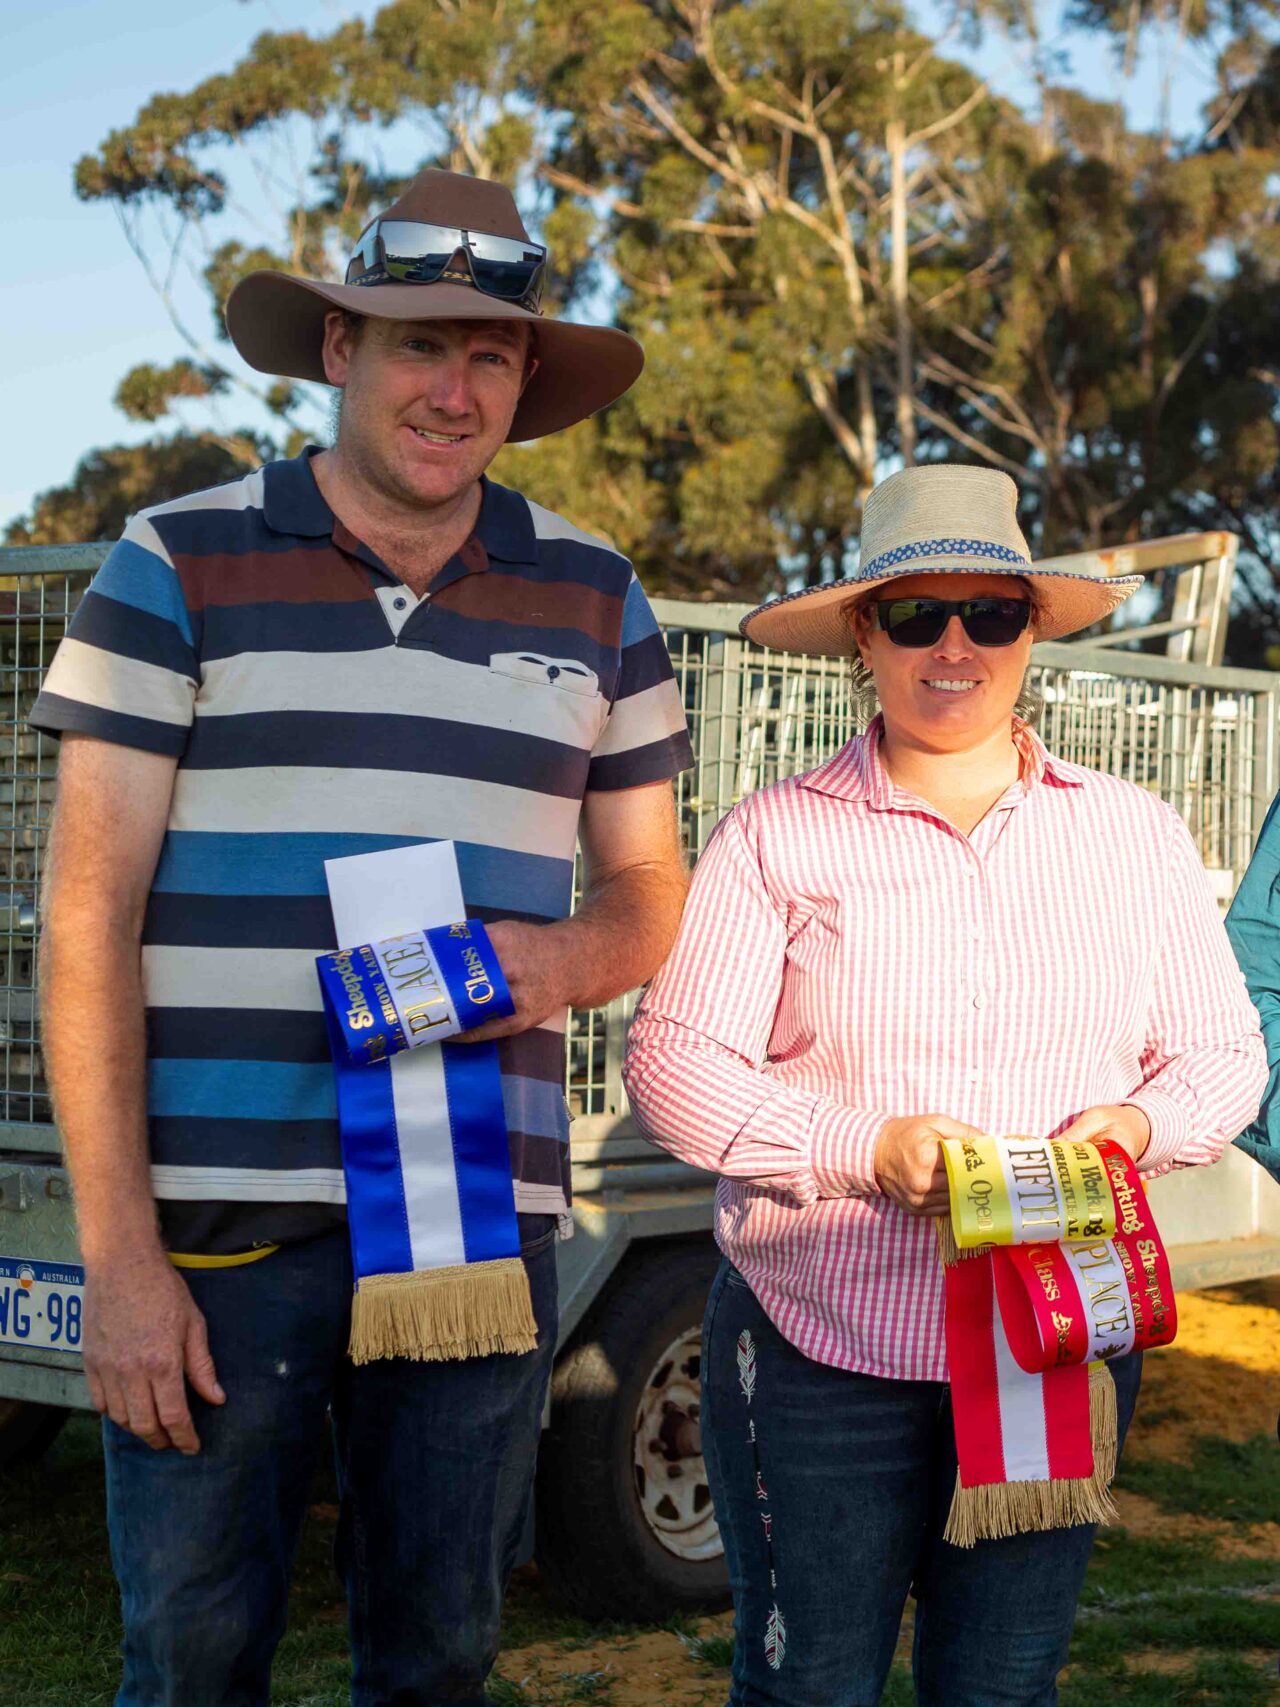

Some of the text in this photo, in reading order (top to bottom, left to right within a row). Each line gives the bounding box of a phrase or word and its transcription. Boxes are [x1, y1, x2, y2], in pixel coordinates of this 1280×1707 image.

[359, 947, 380, 978] YARD
[381, 941, 451, 1036] PLACE
[461, 946, 494, 1004] Class
[373, 982, 399, 1025] SHOW
[967, 1179, 994, 1232] Open
[1008, 1148, 1060, 1230] FIFTH
[1080, 1165, 1107, 1237] Working
[1105, 1153, 1170, 1337] Working Sheepdog
[1115, 1241, 1137, 1284] SHOW
[42, 1272, 80, 1284] AUSTRALIA
[1027, 1247, 1061, 1302] Class
[1070, 1240, 1131, 1338] PLACE
